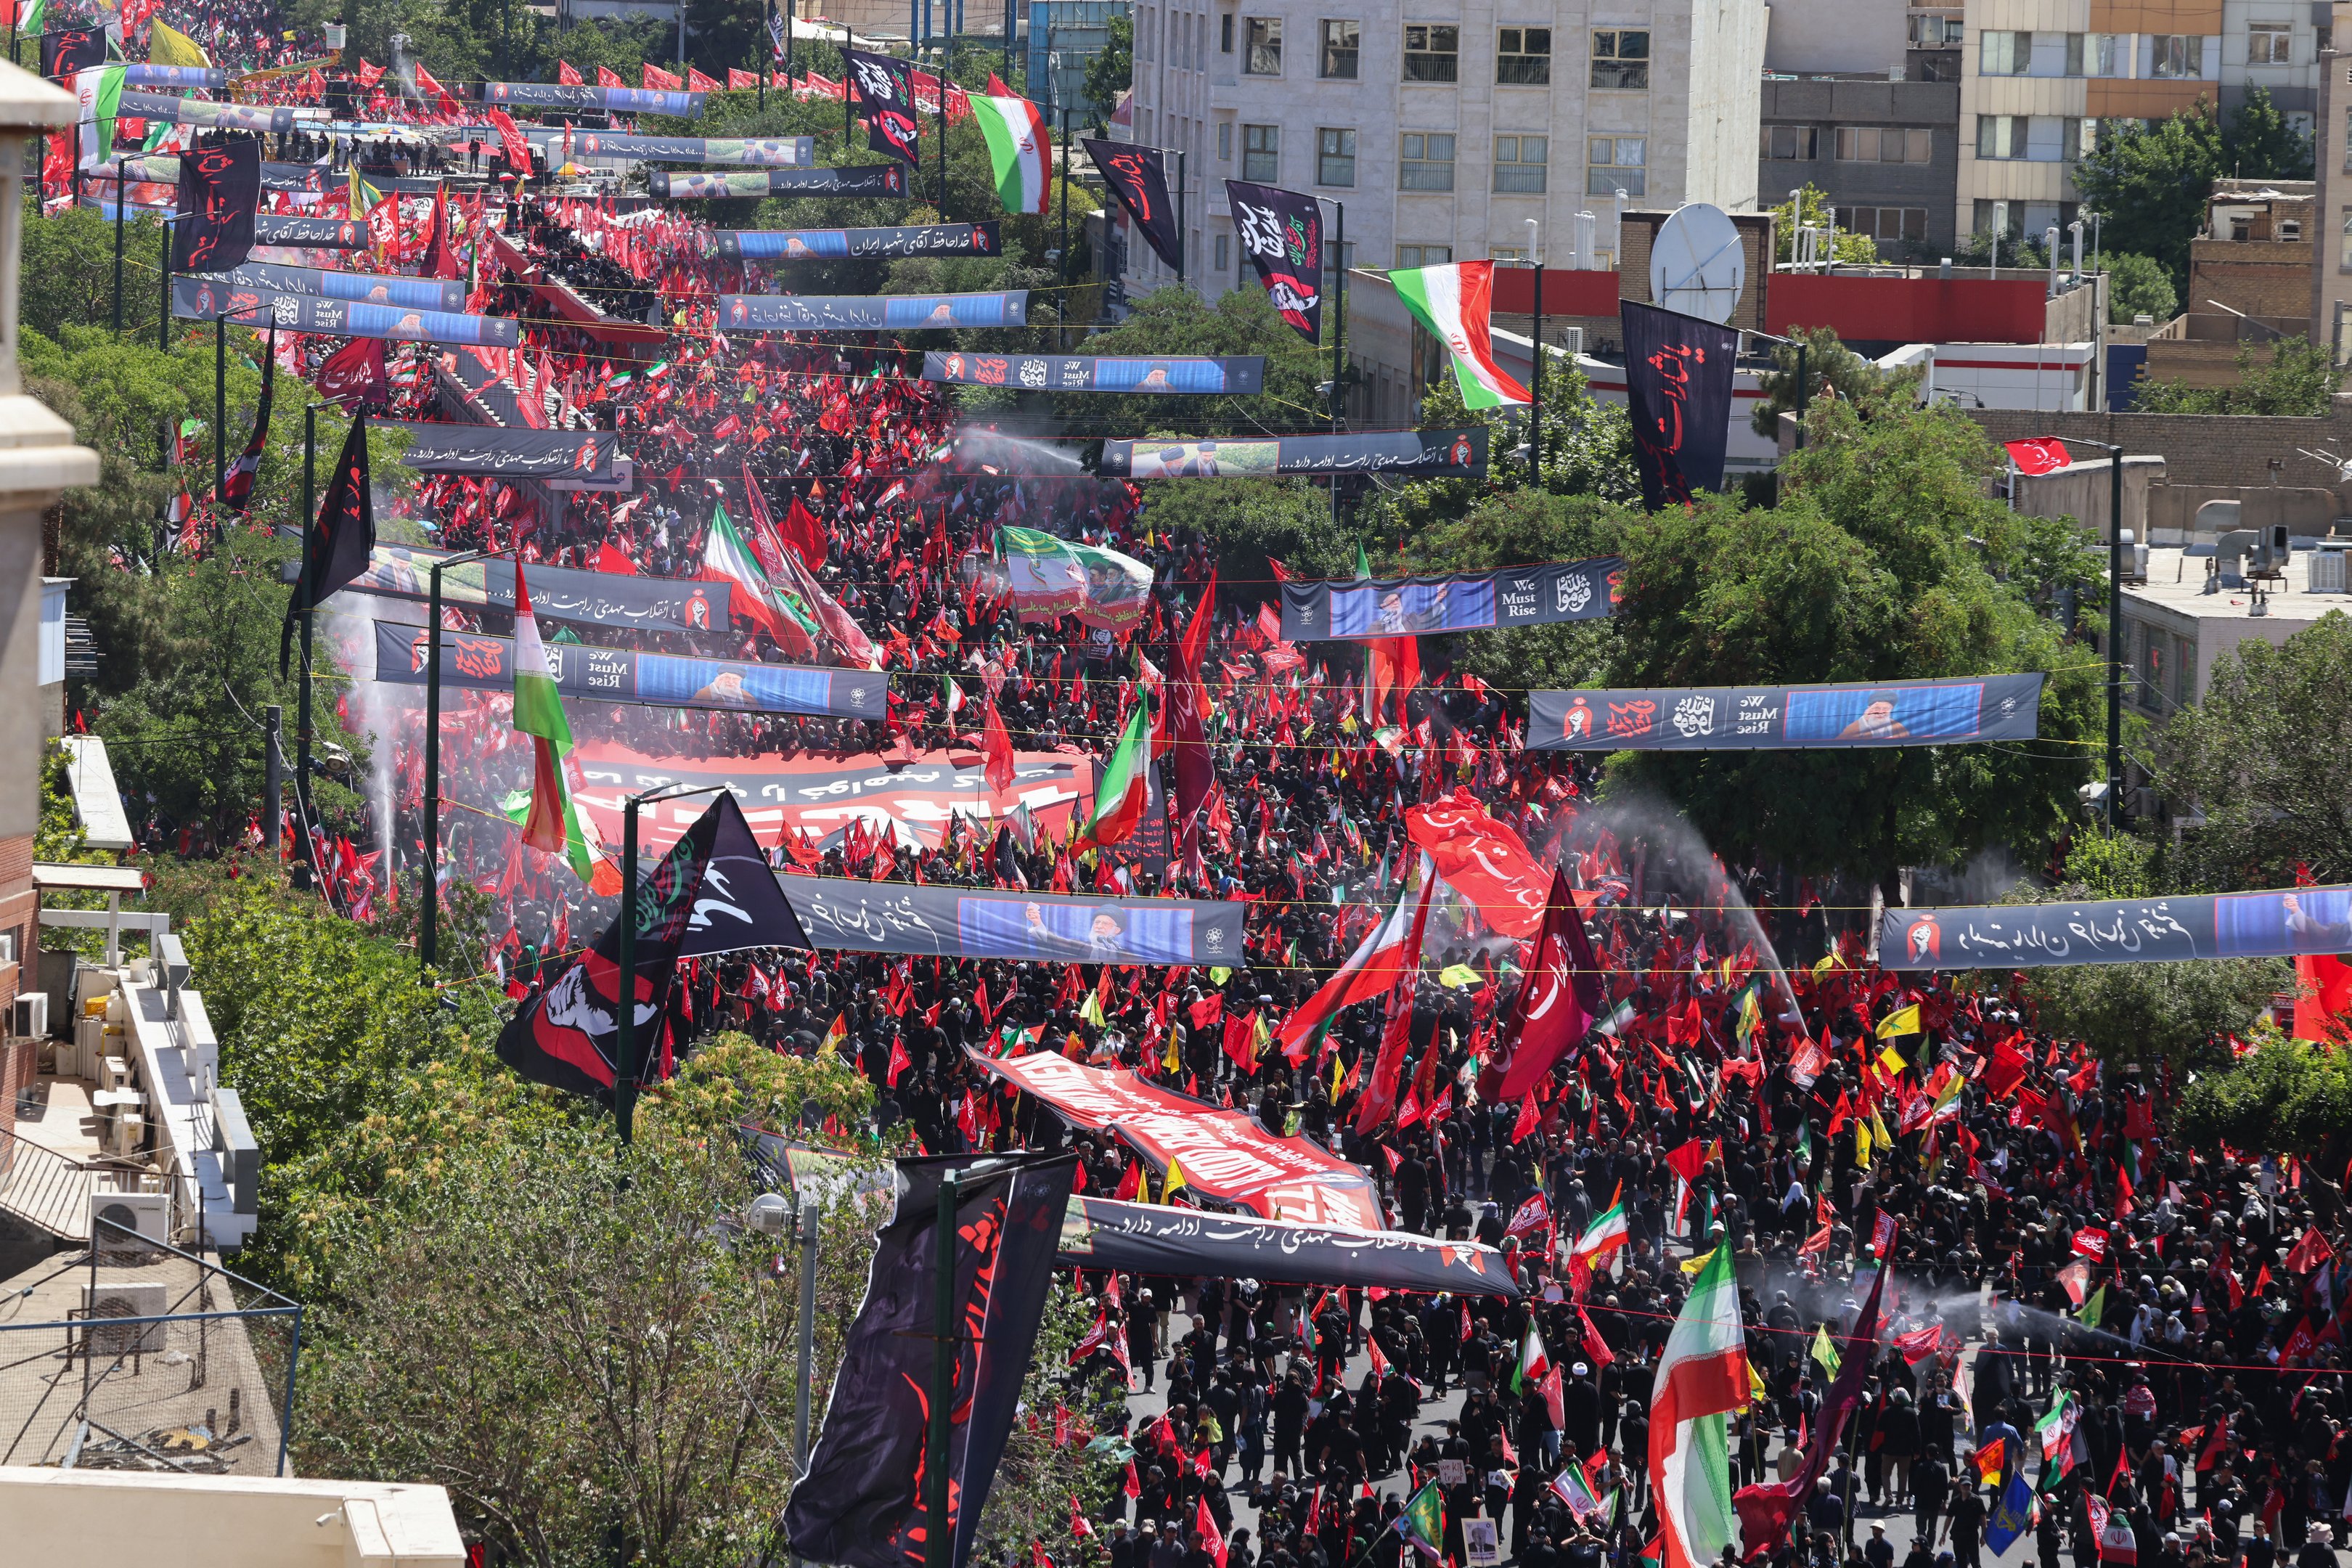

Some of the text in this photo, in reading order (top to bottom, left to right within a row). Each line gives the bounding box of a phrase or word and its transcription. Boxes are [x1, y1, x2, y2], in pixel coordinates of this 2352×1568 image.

[266, 220, 301, 245] آقای
[293, 224, 335, 241] خداحافظ
[851, 228, 970, 256] خداحافظ آقای شهید ایران
[433, 448, 460, 461] ادامه
[459, 448, 495, 466] راهت
[494, 450, 523, 469] مهدی
[520, 446, 562, 470] انقلاب
[563, 448, 574, 465] تا
[1310, 454, 1335, 468] ادامه
[1336, 453, 1371, 472] راهت
[1371, 453, 1398, 470] مهدی
[1397, 446, 1436, 468] انقلاب
[1437, 446, 1447, 463] تا
[1512, 579, 1536, 592] We
[552, 595, 593, 616] راهت
[1501, 592, 1536, 605] Must
[594, 598, 625, 619] مهدی
[624, 601, 669, 623] انقلاب
[671, 601, 681, 619] تا
[1508, 605, 1537, 617] Rise
[583, 770, 622, 784] ما
[762, 783, 786, 802] را
[798, 770, 940, 801] خواهیم
[1156, 1218, 1200, 1237] ادامه
[1205, 1221, 1277, 1249] راهت
